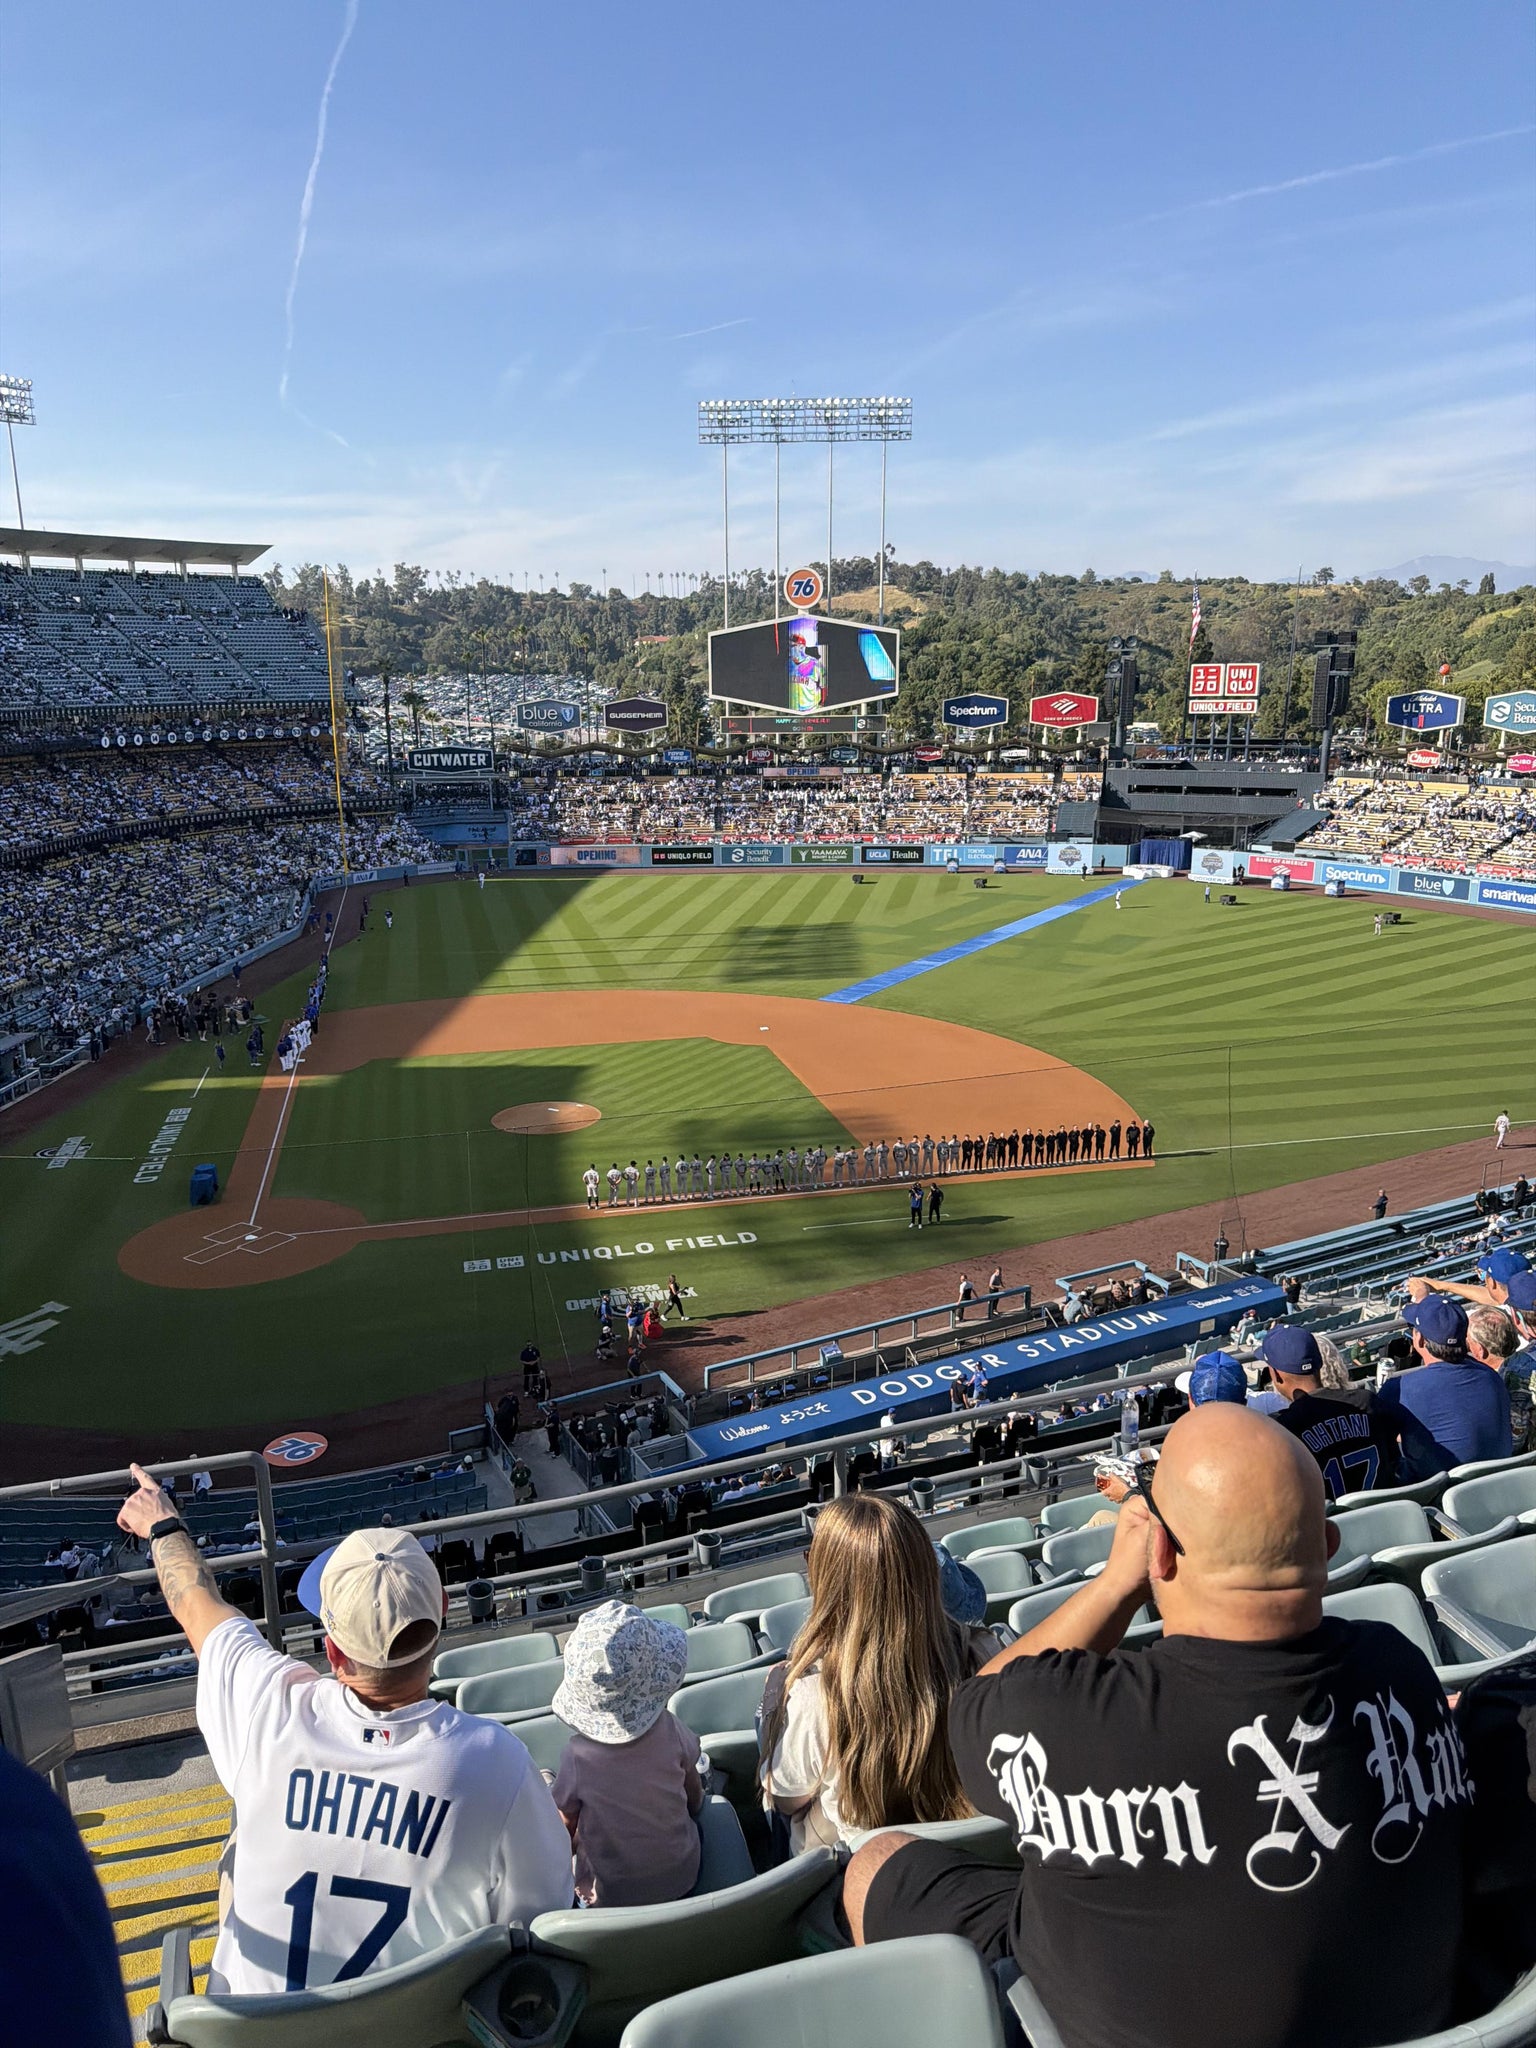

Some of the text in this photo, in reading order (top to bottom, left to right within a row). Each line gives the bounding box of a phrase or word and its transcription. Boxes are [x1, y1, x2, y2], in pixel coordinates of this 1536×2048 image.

[792, 578, 815, 598] 76
[1230, 668, 1252, 679] UNI
[1230, 680, 1254, 692] QLO
[522, 706, 557, 720] blue
[950, 706, 997, 718] Spectrum
[1193, 702, 1253, 712] UNIQLO FIELD
[1402, 703, 1443, 713] ULTRA
[414, 753, 487, 767] CUTWATER
[752, 750, 770, 759] JINRO
[1409, 754, 1438, 764] Churu
[787, 767, 820, 775] OPENING
[539, 854, 549, 863] 76
[577, 850, 617, 861] OPENING
[692, 852, 712, 860] FIELD
[746, 848, 773, 857] Security
[892, 850, 919, 859] Health
[1016, 848, 1042, 859] ANA
[746, 855, 771, 863] Benefit
[1281, 859, 1308, 867] AMERICA
[1325, 867, 1380, 884] Spectrum
[1414, 876, 1442, 891] blue
[537, 1231, 758, 1265] UNIQLO FIELD
[850, 1310, 1168, 1405] DODGER STADIUM
[780, 1402, 831, 1424] ようこそ
[719, 1424, 771, 1442] Welcome
[1301, 1413, 1370, 1453] OHTANI
[265, 1437, 325, 1461] 76
[1323, 1444, 1380, 1500] 17
[987, 1731, 1218, 1868] Born
[285, 1767, 451, 1860] OHTANI
[284, 1871, 411, 1992] 17
